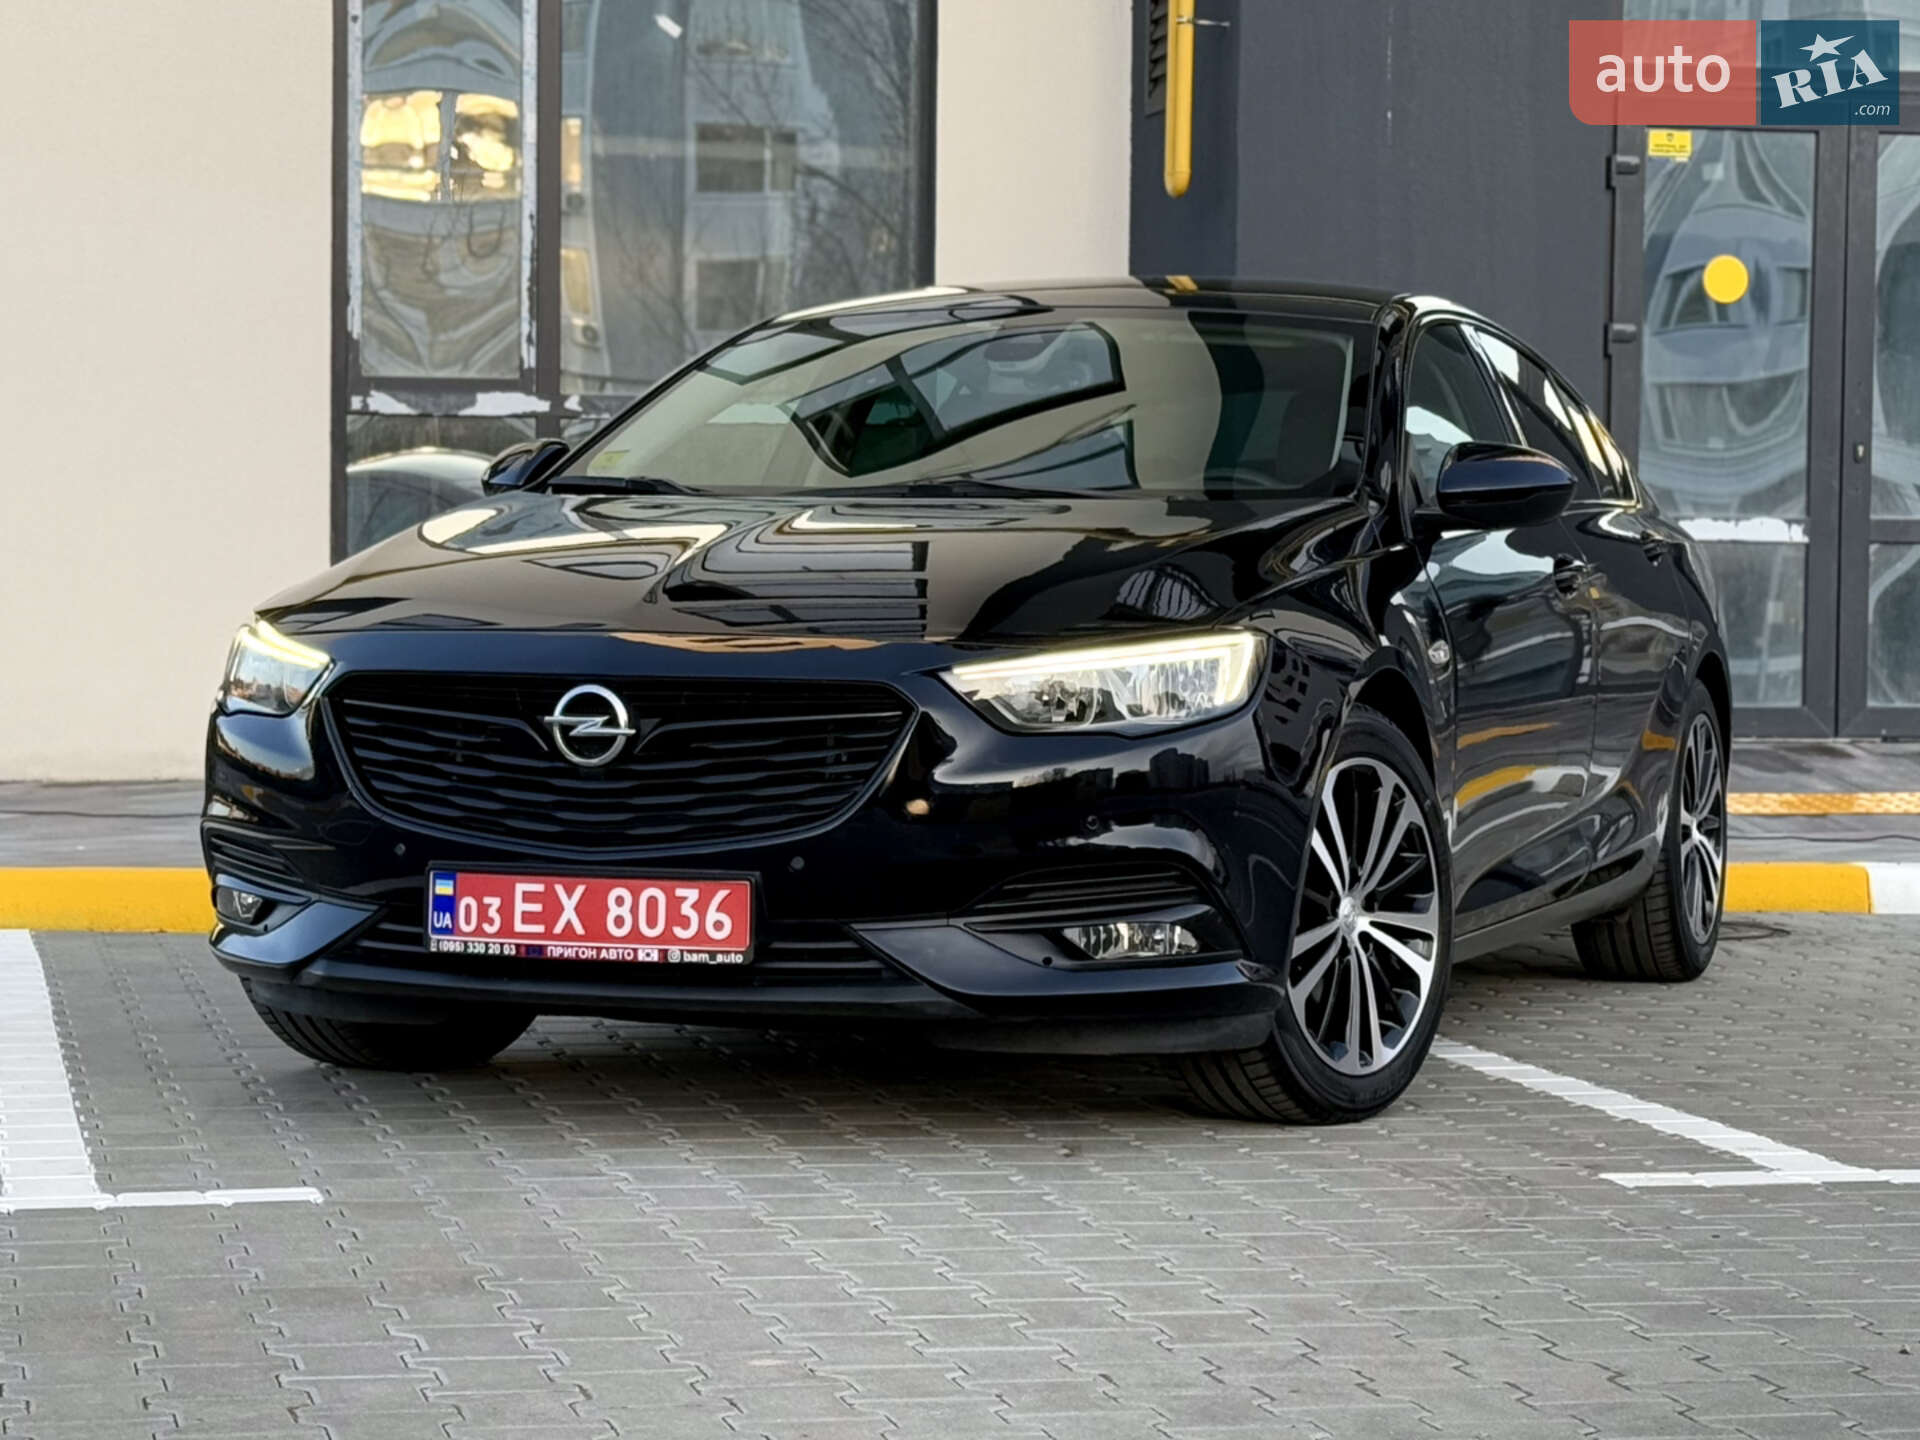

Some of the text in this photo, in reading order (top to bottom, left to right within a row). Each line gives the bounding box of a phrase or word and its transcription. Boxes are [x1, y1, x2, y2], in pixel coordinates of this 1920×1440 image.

[458, 882, 732, 940] 03 EX 8036
[433, 911, 452, 929] UA
[488, 943, 501, 955] 20
[547, 946, 633, 961] ПРИГОН АВТО
[683, 951, 744, 964] bam_auto
